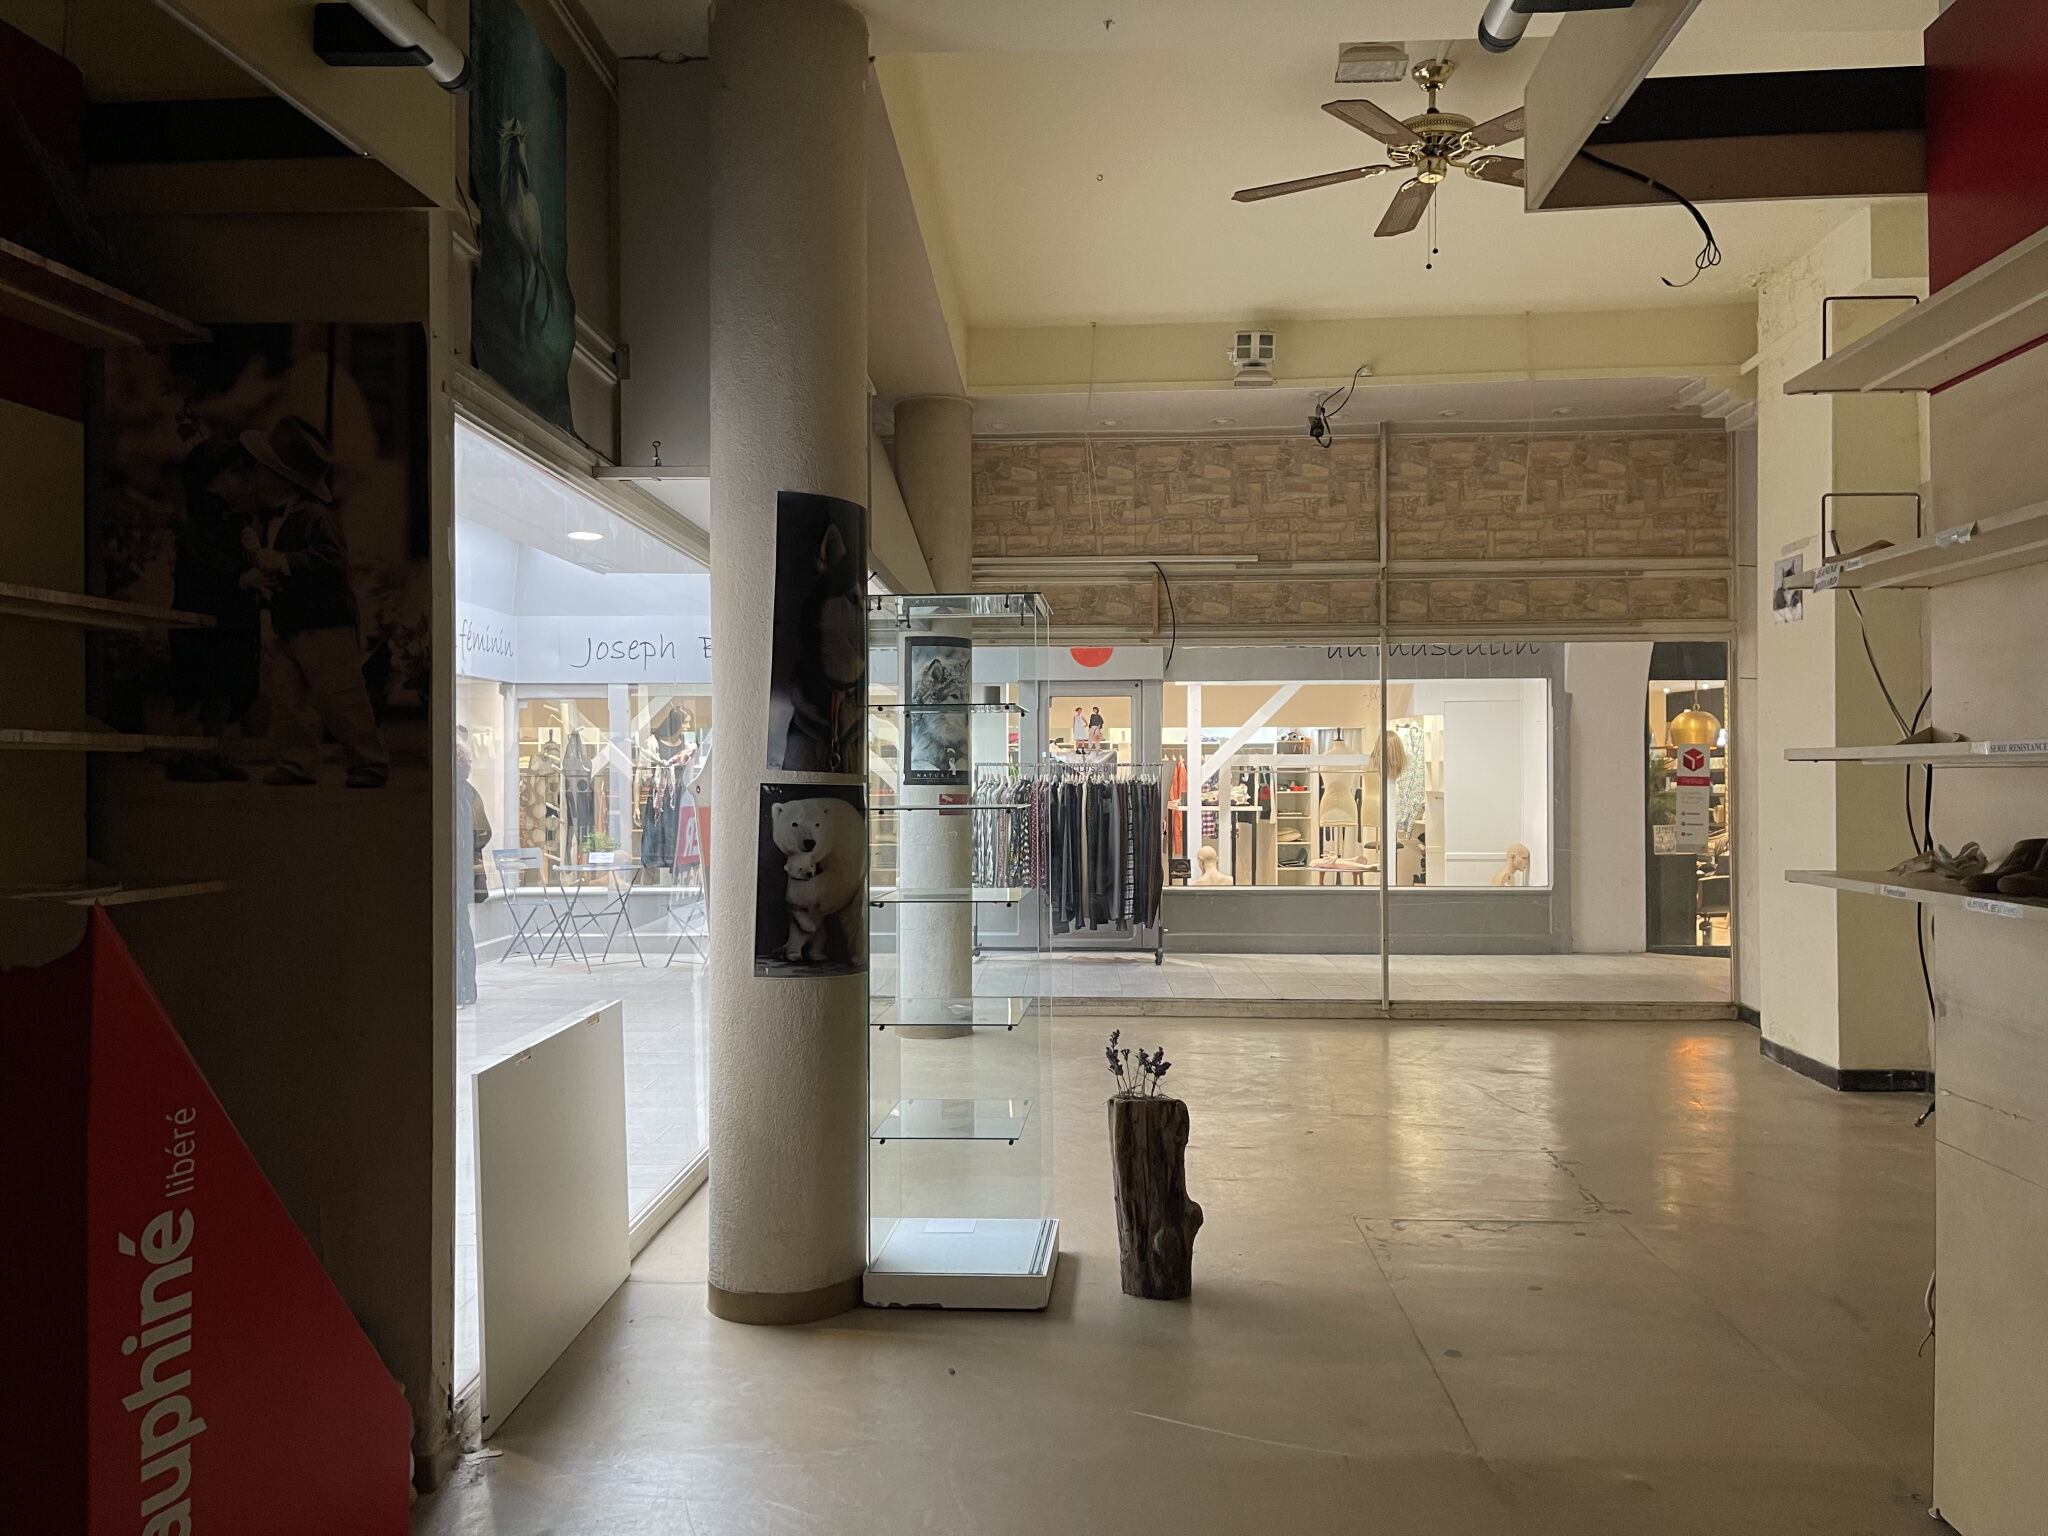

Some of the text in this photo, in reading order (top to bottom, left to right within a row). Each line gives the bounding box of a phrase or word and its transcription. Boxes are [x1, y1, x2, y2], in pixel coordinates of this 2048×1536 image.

[459, 618, 514, 662] féminin
[569, 633, 676, 670] Joseph
[164, 1106, 197, 1198] libéré
